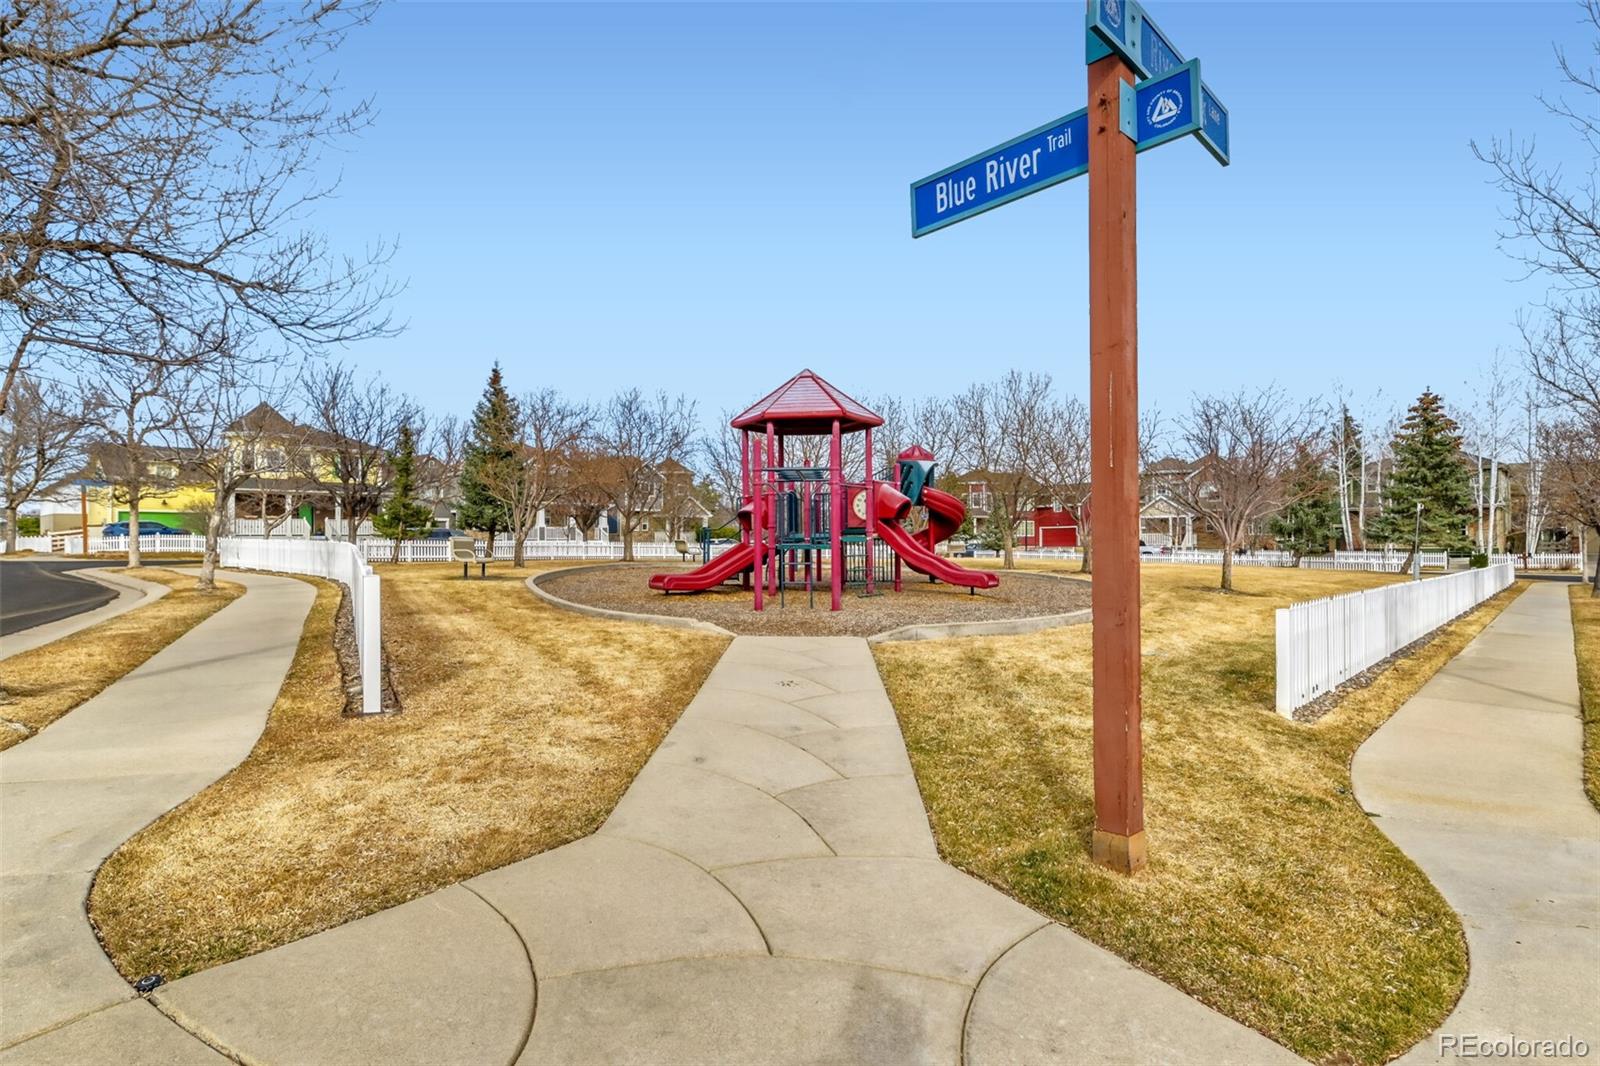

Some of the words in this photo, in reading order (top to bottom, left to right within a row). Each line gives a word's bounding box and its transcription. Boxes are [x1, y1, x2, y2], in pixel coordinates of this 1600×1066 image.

[935, 178, 977, 214] Blue
[985, 147, 1041, 193] River
[1047, 127, 1072, 153] Trail
